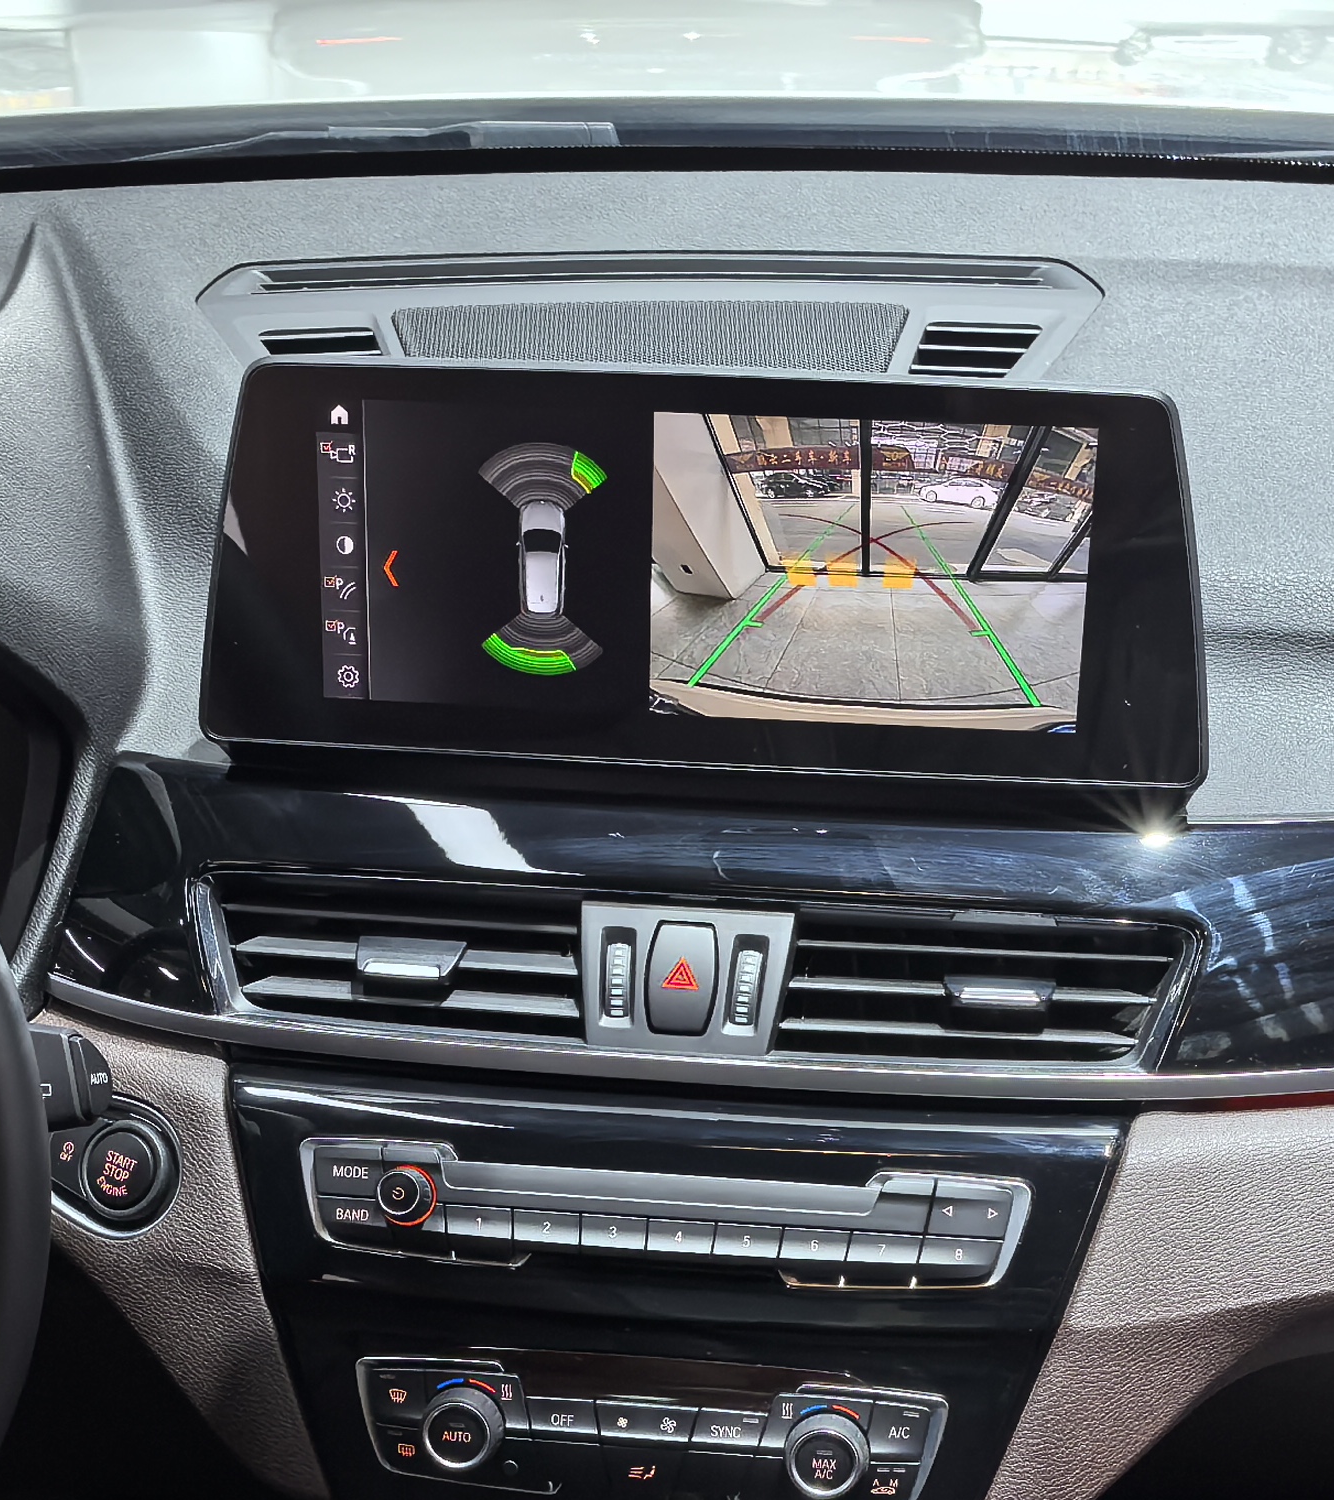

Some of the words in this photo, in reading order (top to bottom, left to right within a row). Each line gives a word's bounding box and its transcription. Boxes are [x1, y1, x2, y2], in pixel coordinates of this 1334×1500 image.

[90, 1072, 109, 1086] AUTO
[106, 1150, 138, 1171] START
[102, 1162, 130, 1182] STOP
[332, 1164, 369, 1179] MODE
[96, 1175, 129, 1197] ENGINE
[335, 1207, 370, 1222] BAND
[475, 1217, 484, 1231] 1
[540, 1221, 552, 1236] 2
[607, 1225, 618, 1240] 3
[673, 1230, 685, 1245] 4
[740, 1234, 752, 1249] 5
[808, 1238, 820, 1253] 6
[875, 1242, 887, 1257] 7
[953, 1247, 965, 1262] 8
[550, 1413, 574, 1428] OFF
[441, 1430, 472, 1444] AUTO
[710, 1424, 742, 1440] SYNC
[888, 1426, 910, 1439] A/C
[812, 1458, 837, 1470] MAX
[813, 1470, 833, 1480] A/C
